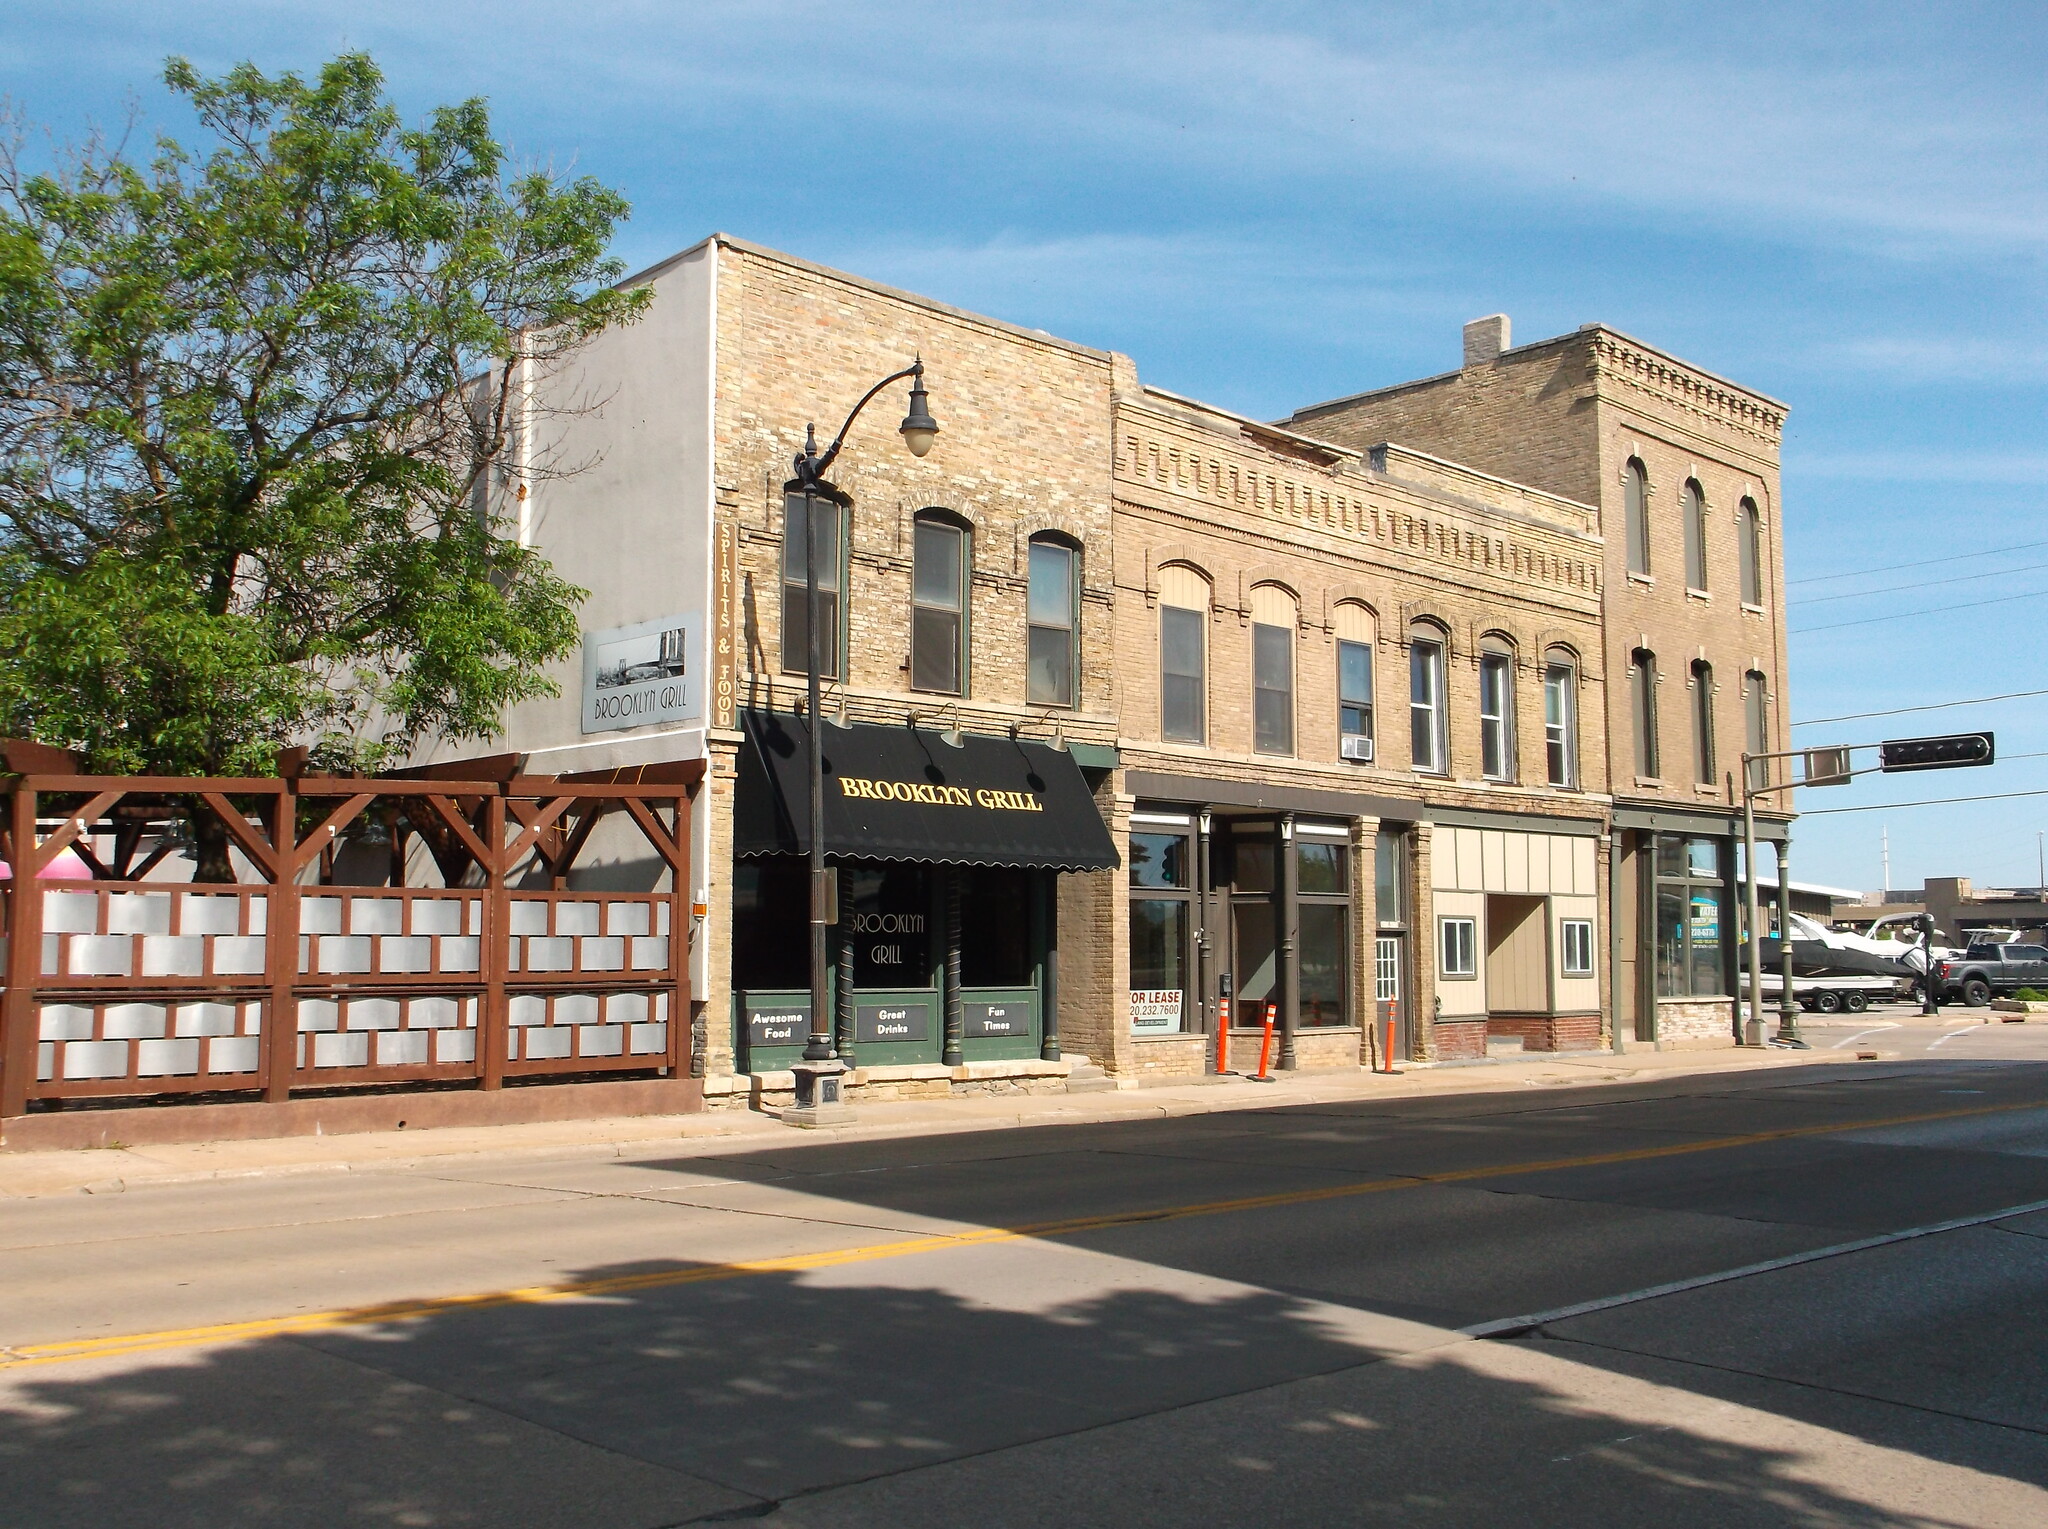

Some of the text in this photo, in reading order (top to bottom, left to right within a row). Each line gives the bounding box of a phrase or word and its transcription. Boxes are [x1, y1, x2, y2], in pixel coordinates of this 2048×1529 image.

[720, 523, 731, 627] SPIRITS
[718, 638, 731, 654] &
[594, 684, 687, 720] BROOKLYN GRILL
[838, 777, 1044, 812] BROOKLYN GRILL
[871, 944, 903, 964] GRILL
[1129, 991, 1180, 1004] OR LEASE
[878, 1009, 907, 1021] Great
[987, 1006, 1005, 1017] Fun
[1129, 1004, 1179, 1016] 20.232.7600
[751, 1012, 803, 1025] Awesome
[877, 1023, 909, 1035] Drinks
[983, 1020, 1011, 1031] Times
[764, 1027, 792, 1039] Food
